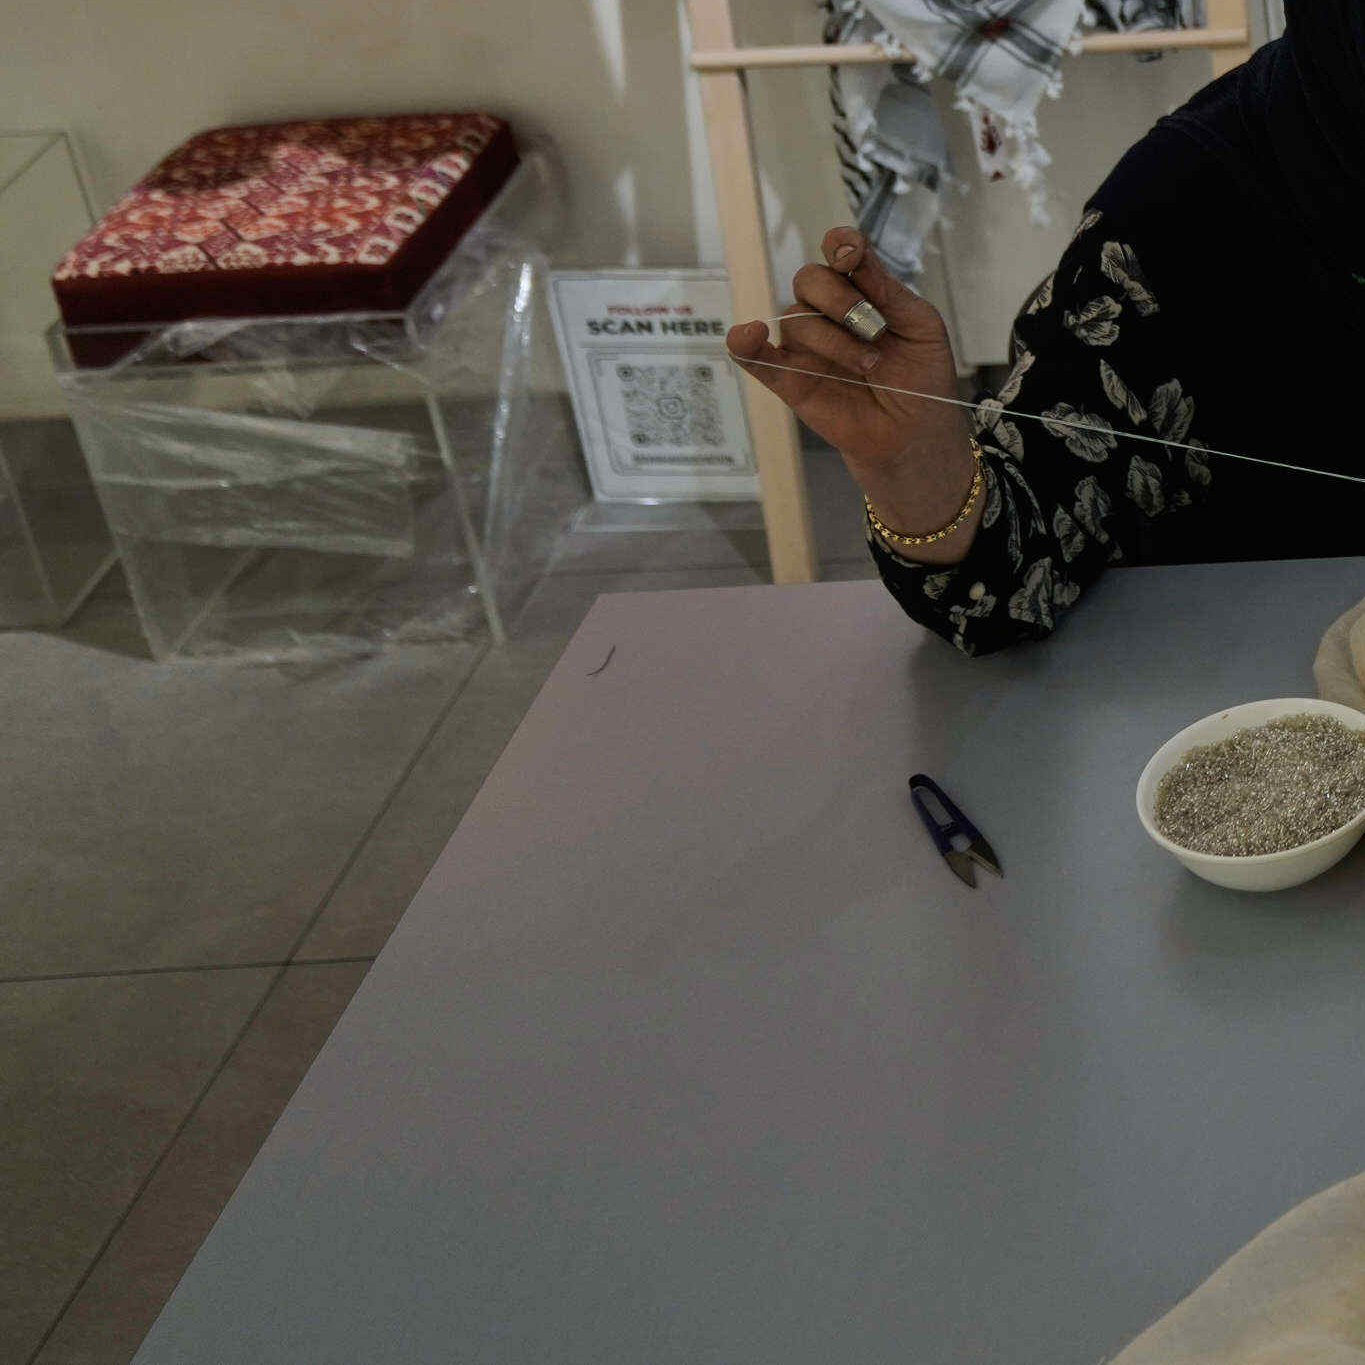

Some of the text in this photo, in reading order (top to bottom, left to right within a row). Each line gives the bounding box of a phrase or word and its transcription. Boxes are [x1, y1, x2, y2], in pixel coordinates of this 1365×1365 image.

[606, 305, 669, 316] FOLLOW
[586, 318, 726, 336] SCAN HERE
